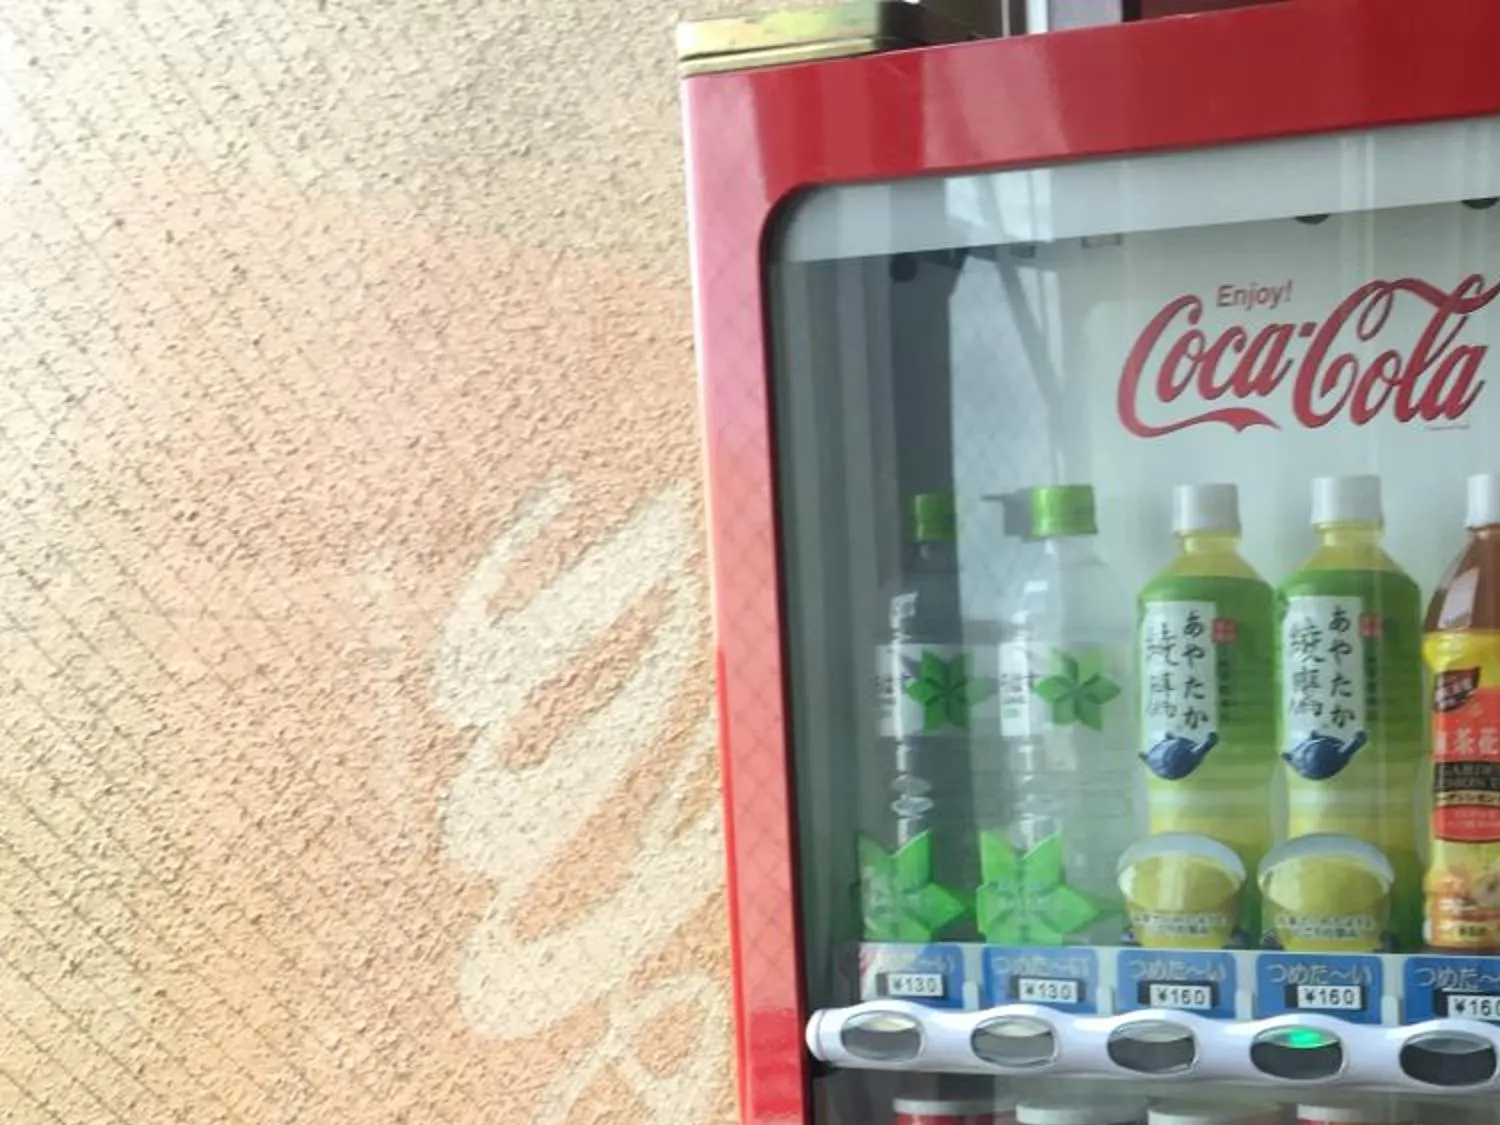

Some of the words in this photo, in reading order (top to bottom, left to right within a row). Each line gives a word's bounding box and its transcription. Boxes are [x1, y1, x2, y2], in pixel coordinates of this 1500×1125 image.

[1215, 279, 1294, 312] Enjoy!
[1181, 608, 1209, 731] あやたか
[1328, 603, 1357, 729] あやたか
[893, 977, 938, 994] ¥130
[1023, 983, 1073, 1002] ¥130
[1157, 987, 1207, 1007] ¥160
[1304, 989, 1357, 1007] ¥160
